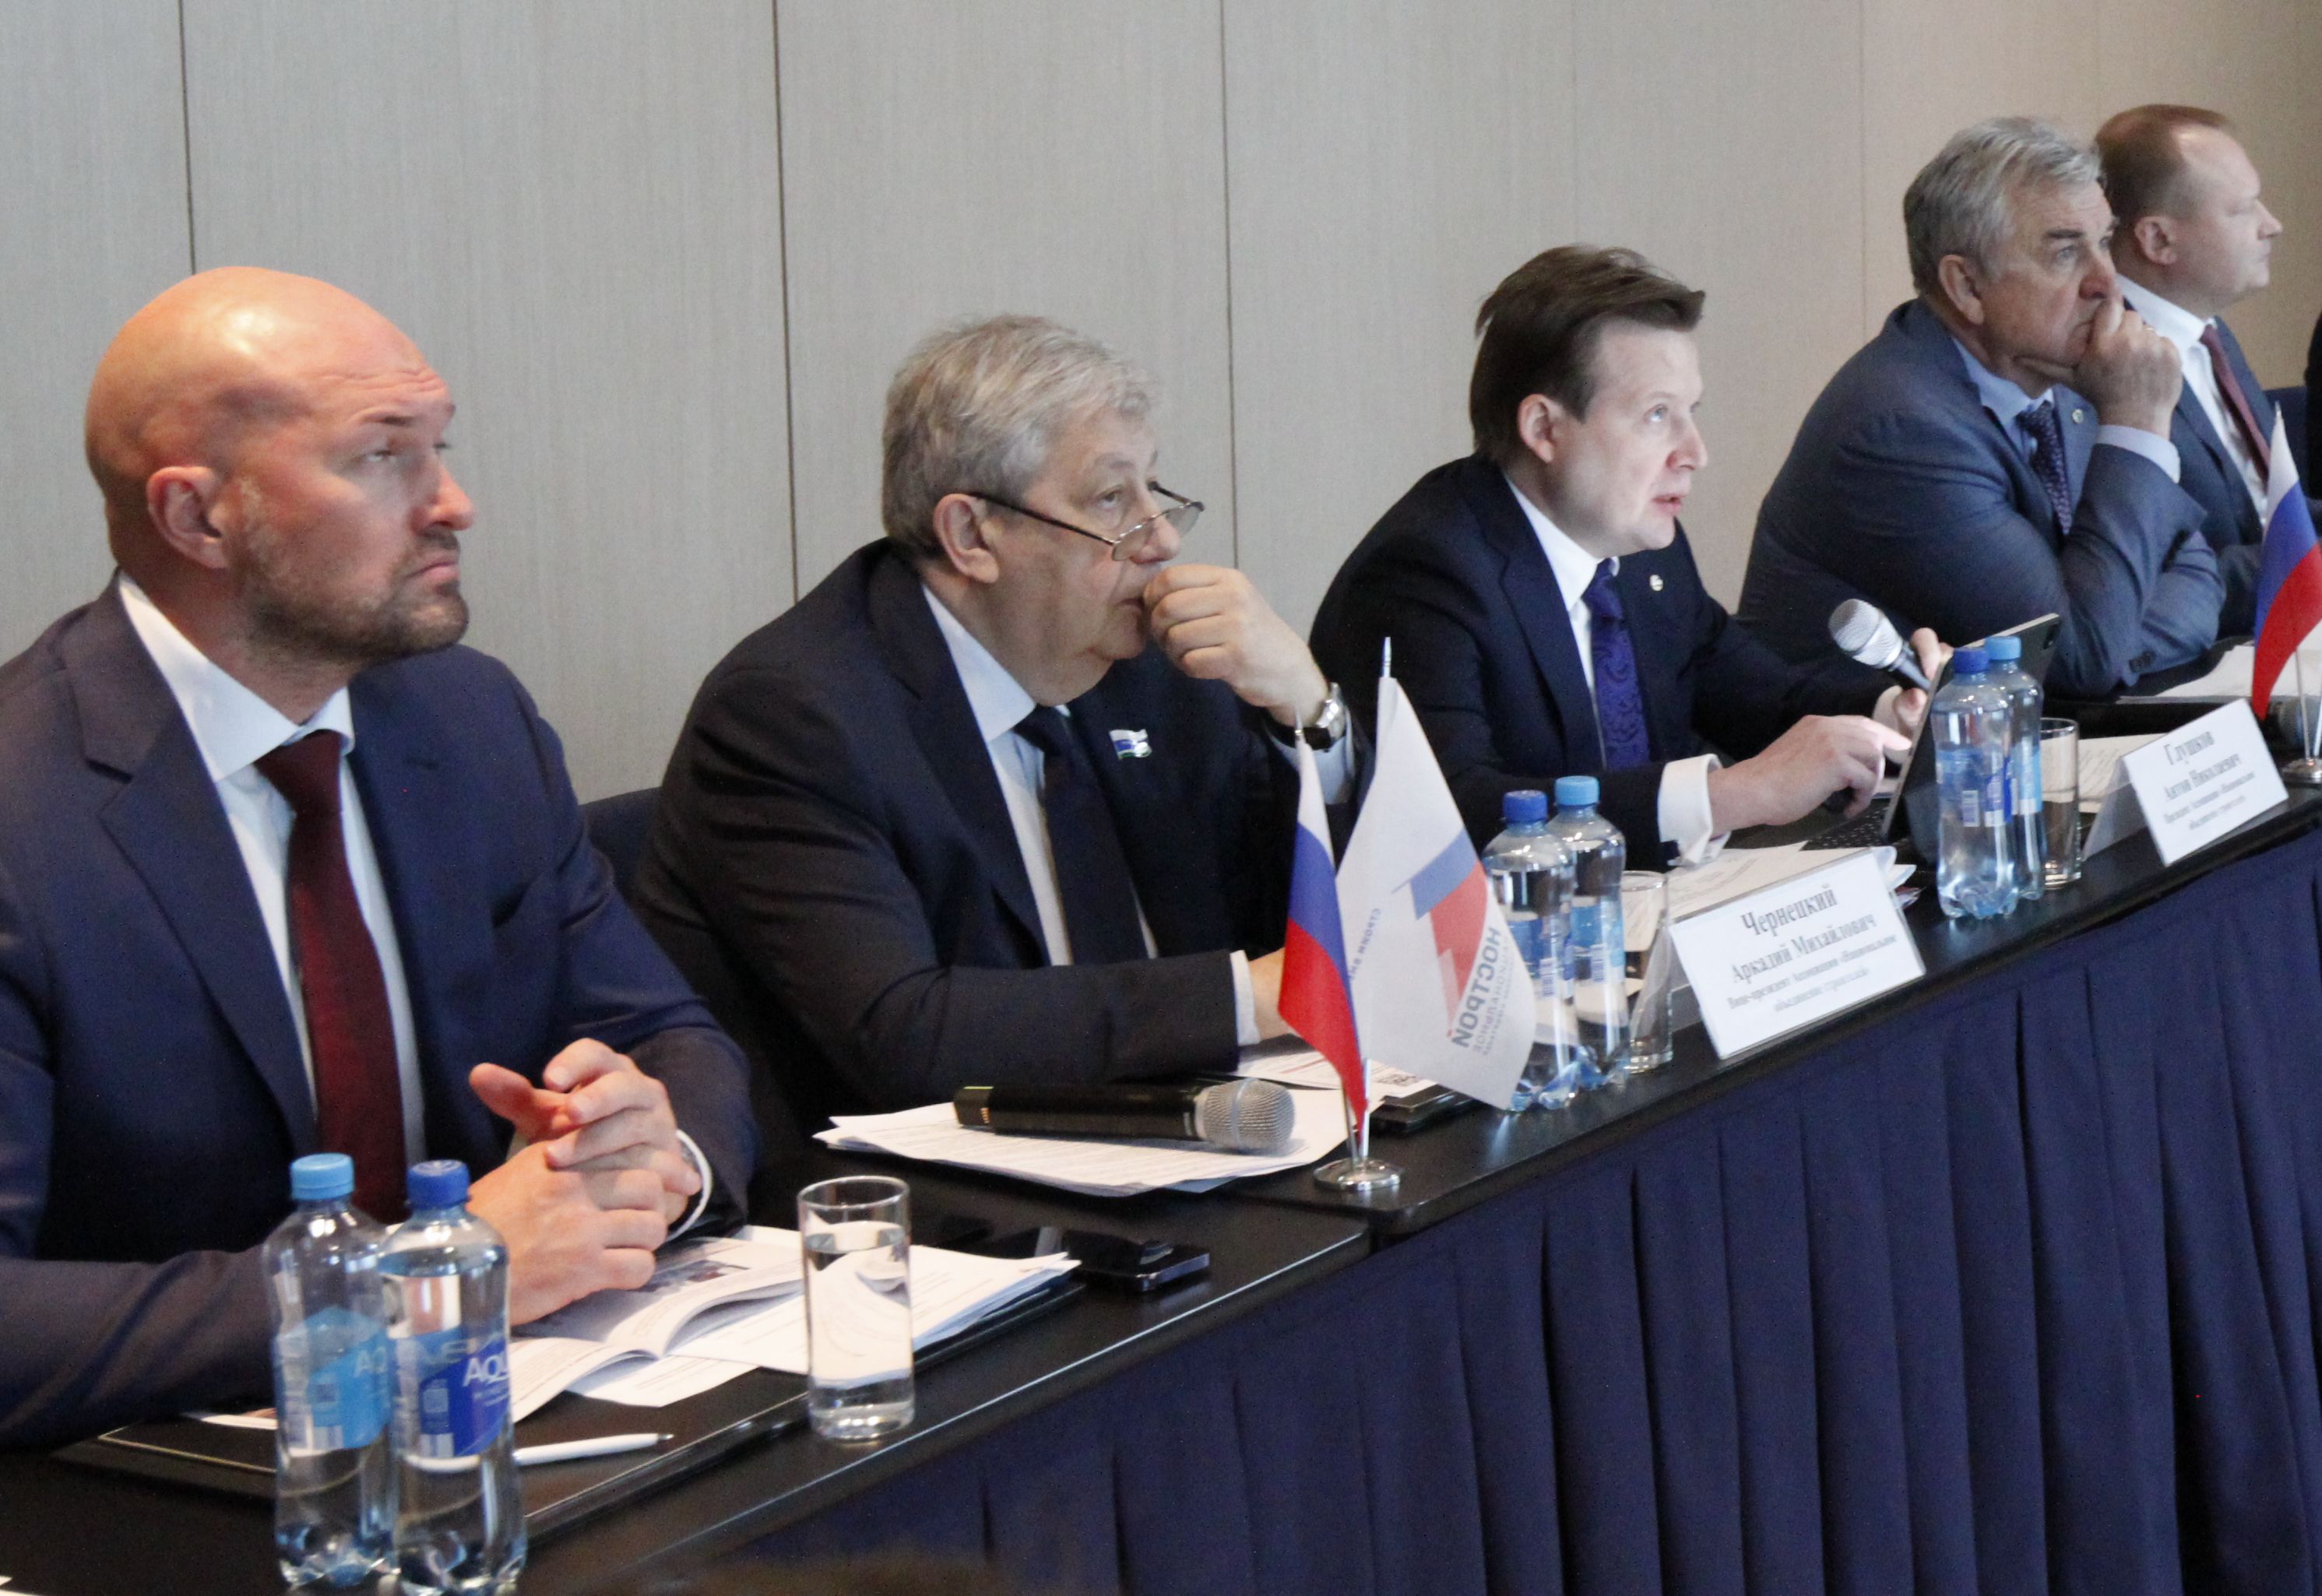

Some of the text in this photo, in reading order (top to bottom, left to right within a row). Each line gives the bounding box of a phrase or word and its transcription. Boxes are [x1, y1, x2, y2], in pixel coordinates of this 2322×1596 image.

[1740, 884, 1838, 936] Чернецкий
[1732, 913, 1877, 983] Аркадий Михайлович
